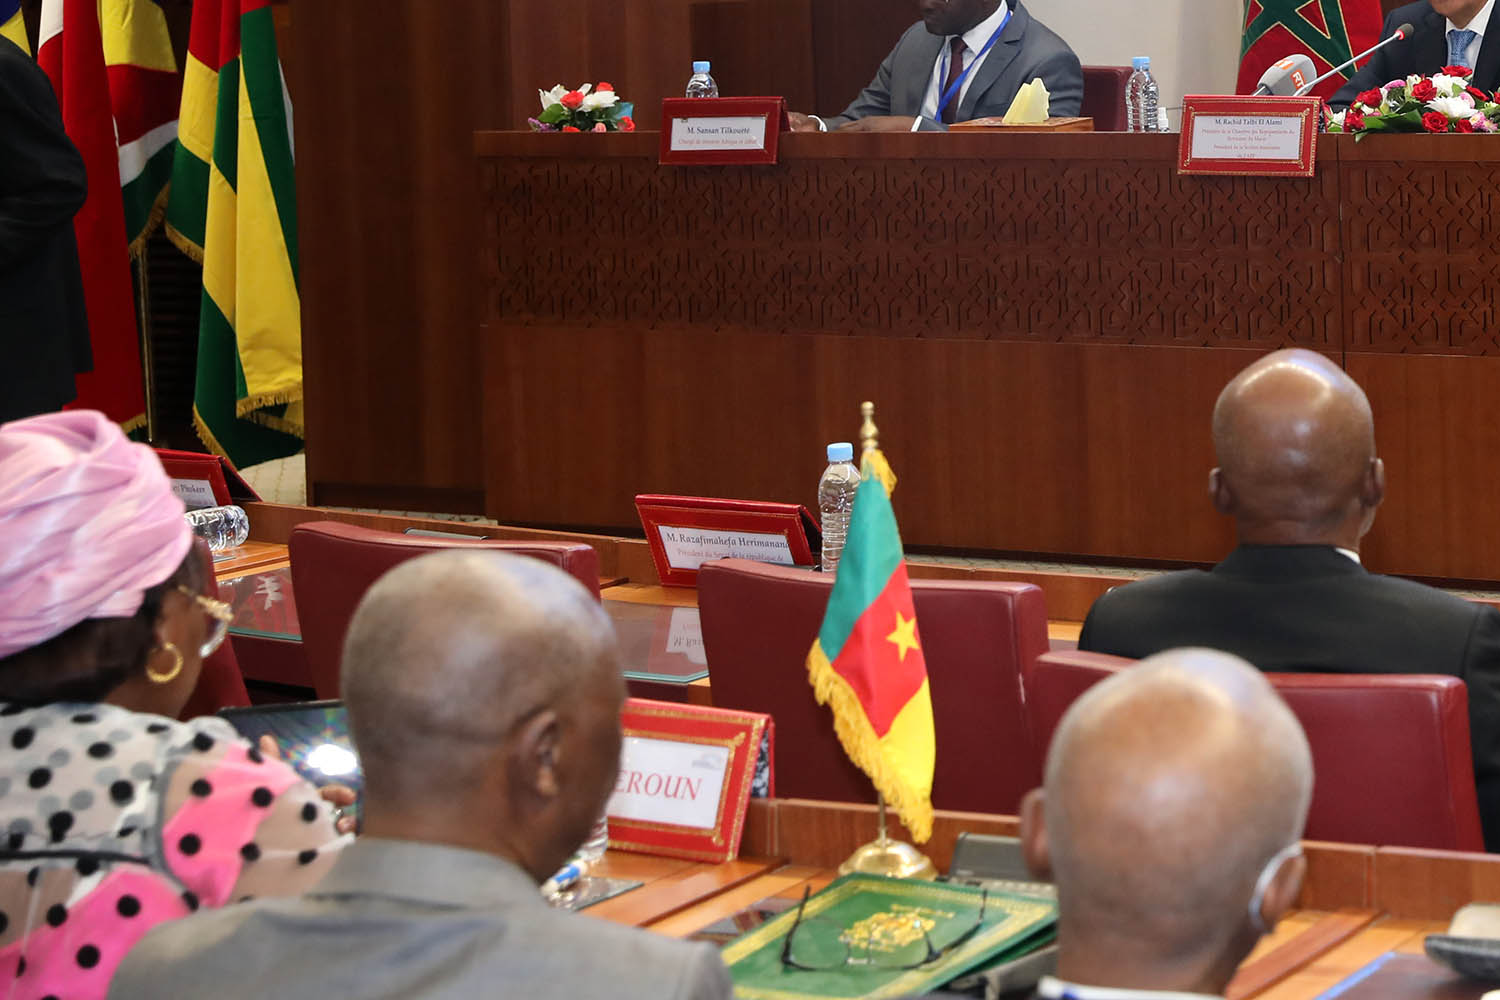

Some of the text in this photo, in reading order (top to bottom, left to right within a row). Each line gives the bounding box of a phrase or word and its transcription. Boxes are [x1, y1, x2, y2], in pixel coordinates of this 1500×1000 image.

[666, 533, 678, 543] M.
[679, 533, 737, 550] Razafimahefa
[615, 769, 704, 801] EROUN
